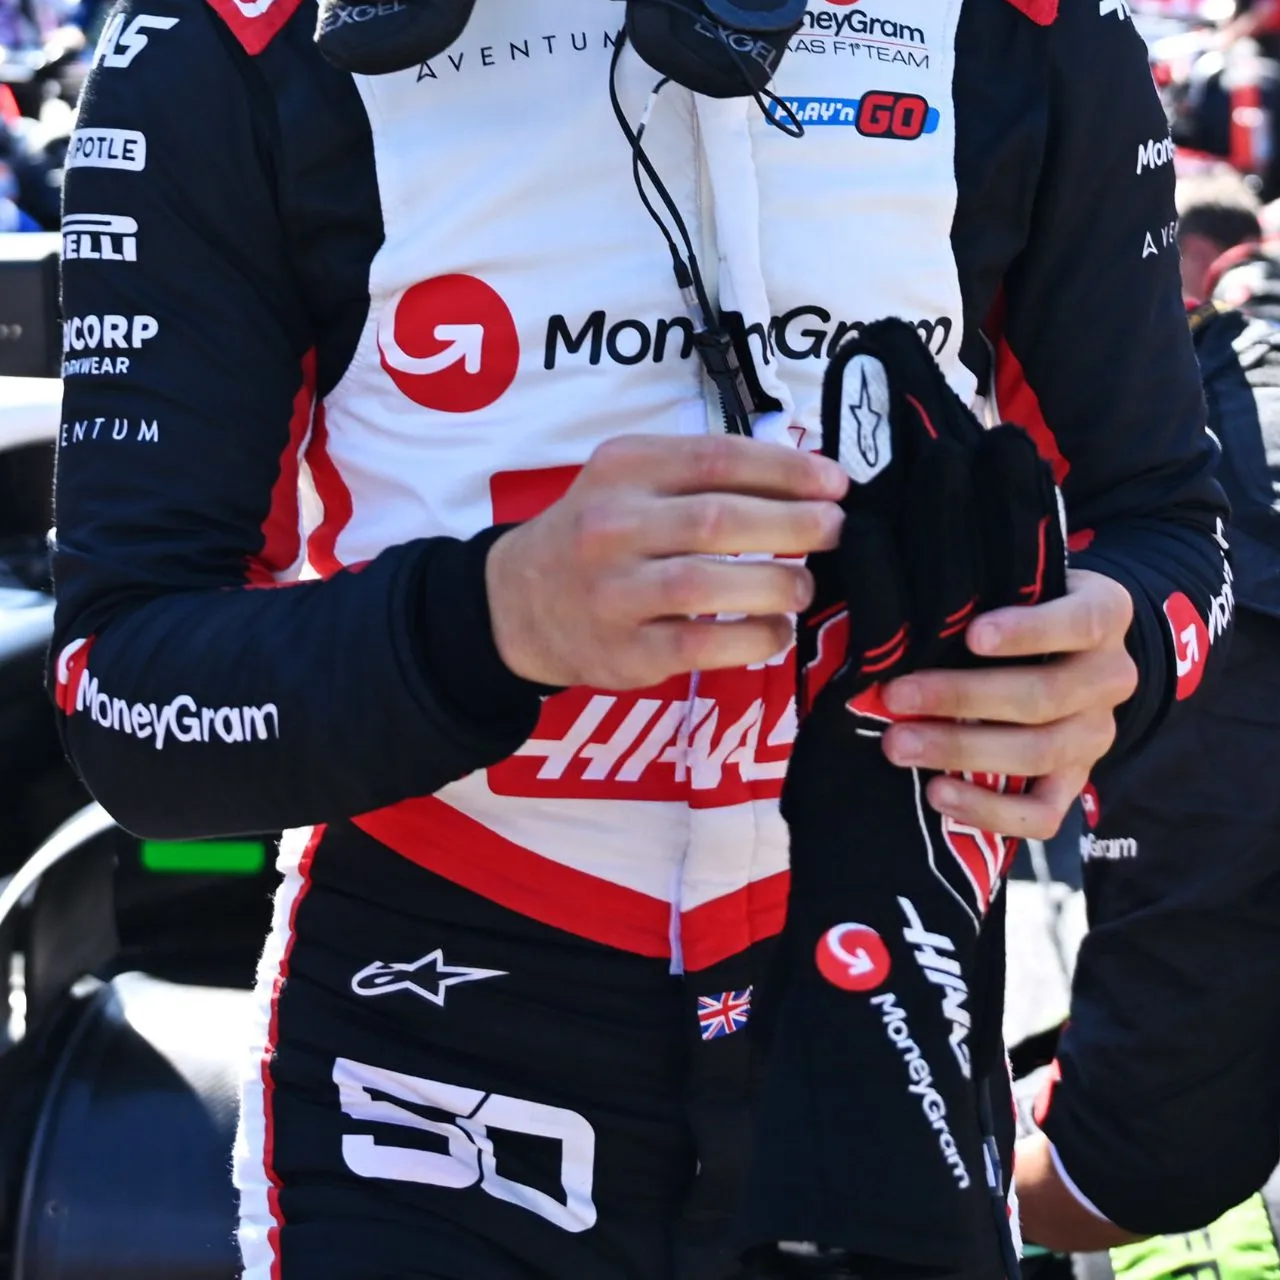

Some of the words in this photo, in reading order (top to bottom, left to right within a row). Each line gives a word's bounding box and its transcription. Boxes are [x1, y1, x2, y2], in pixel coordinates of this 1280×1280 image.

[322, 0, 407, 33] EXGEL
[803, 9, 925, 44] neyGram
[862, 45, 929, 70] TEAM
[858, 93, 926, 137] GO
[74, 135, 138, 162] POTLE
[63, 233, 137, 262] ELLI
[61, 418, 158, 447] ENTUM
[75, 672, 279, 750] MoneyGram
[870, 992, 970, 1190] MoneyGram
[332, 1056, 597, 1233] 50
